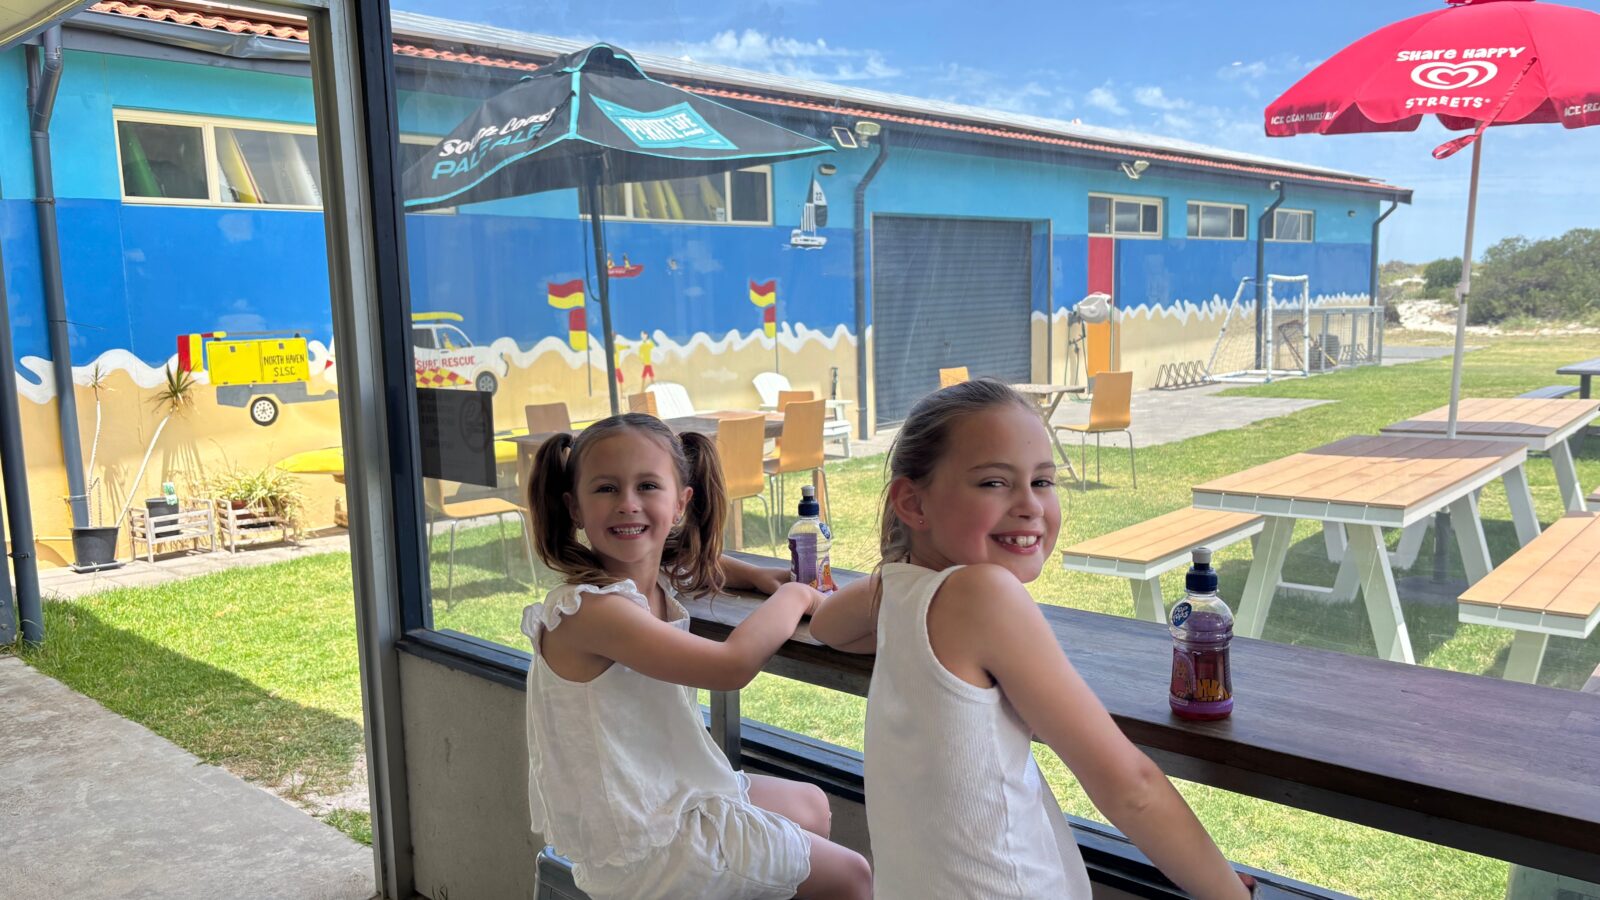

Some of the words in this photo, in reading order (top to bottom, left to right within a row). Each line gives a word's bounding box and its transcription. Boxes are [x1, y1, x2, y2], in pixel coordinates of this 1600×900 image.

[1405, 96, 1484, 109] STREETS
[1564, 105, 1582, 117] ICE
[1583, 102, 1600, 114] CRE
[1271, 116, 1285, 125] ICE
[263, 354, 285, 366] NORTH
[285, 353, 305, 364] HAVEN
[441, 355, 476, 368] RESCUE
